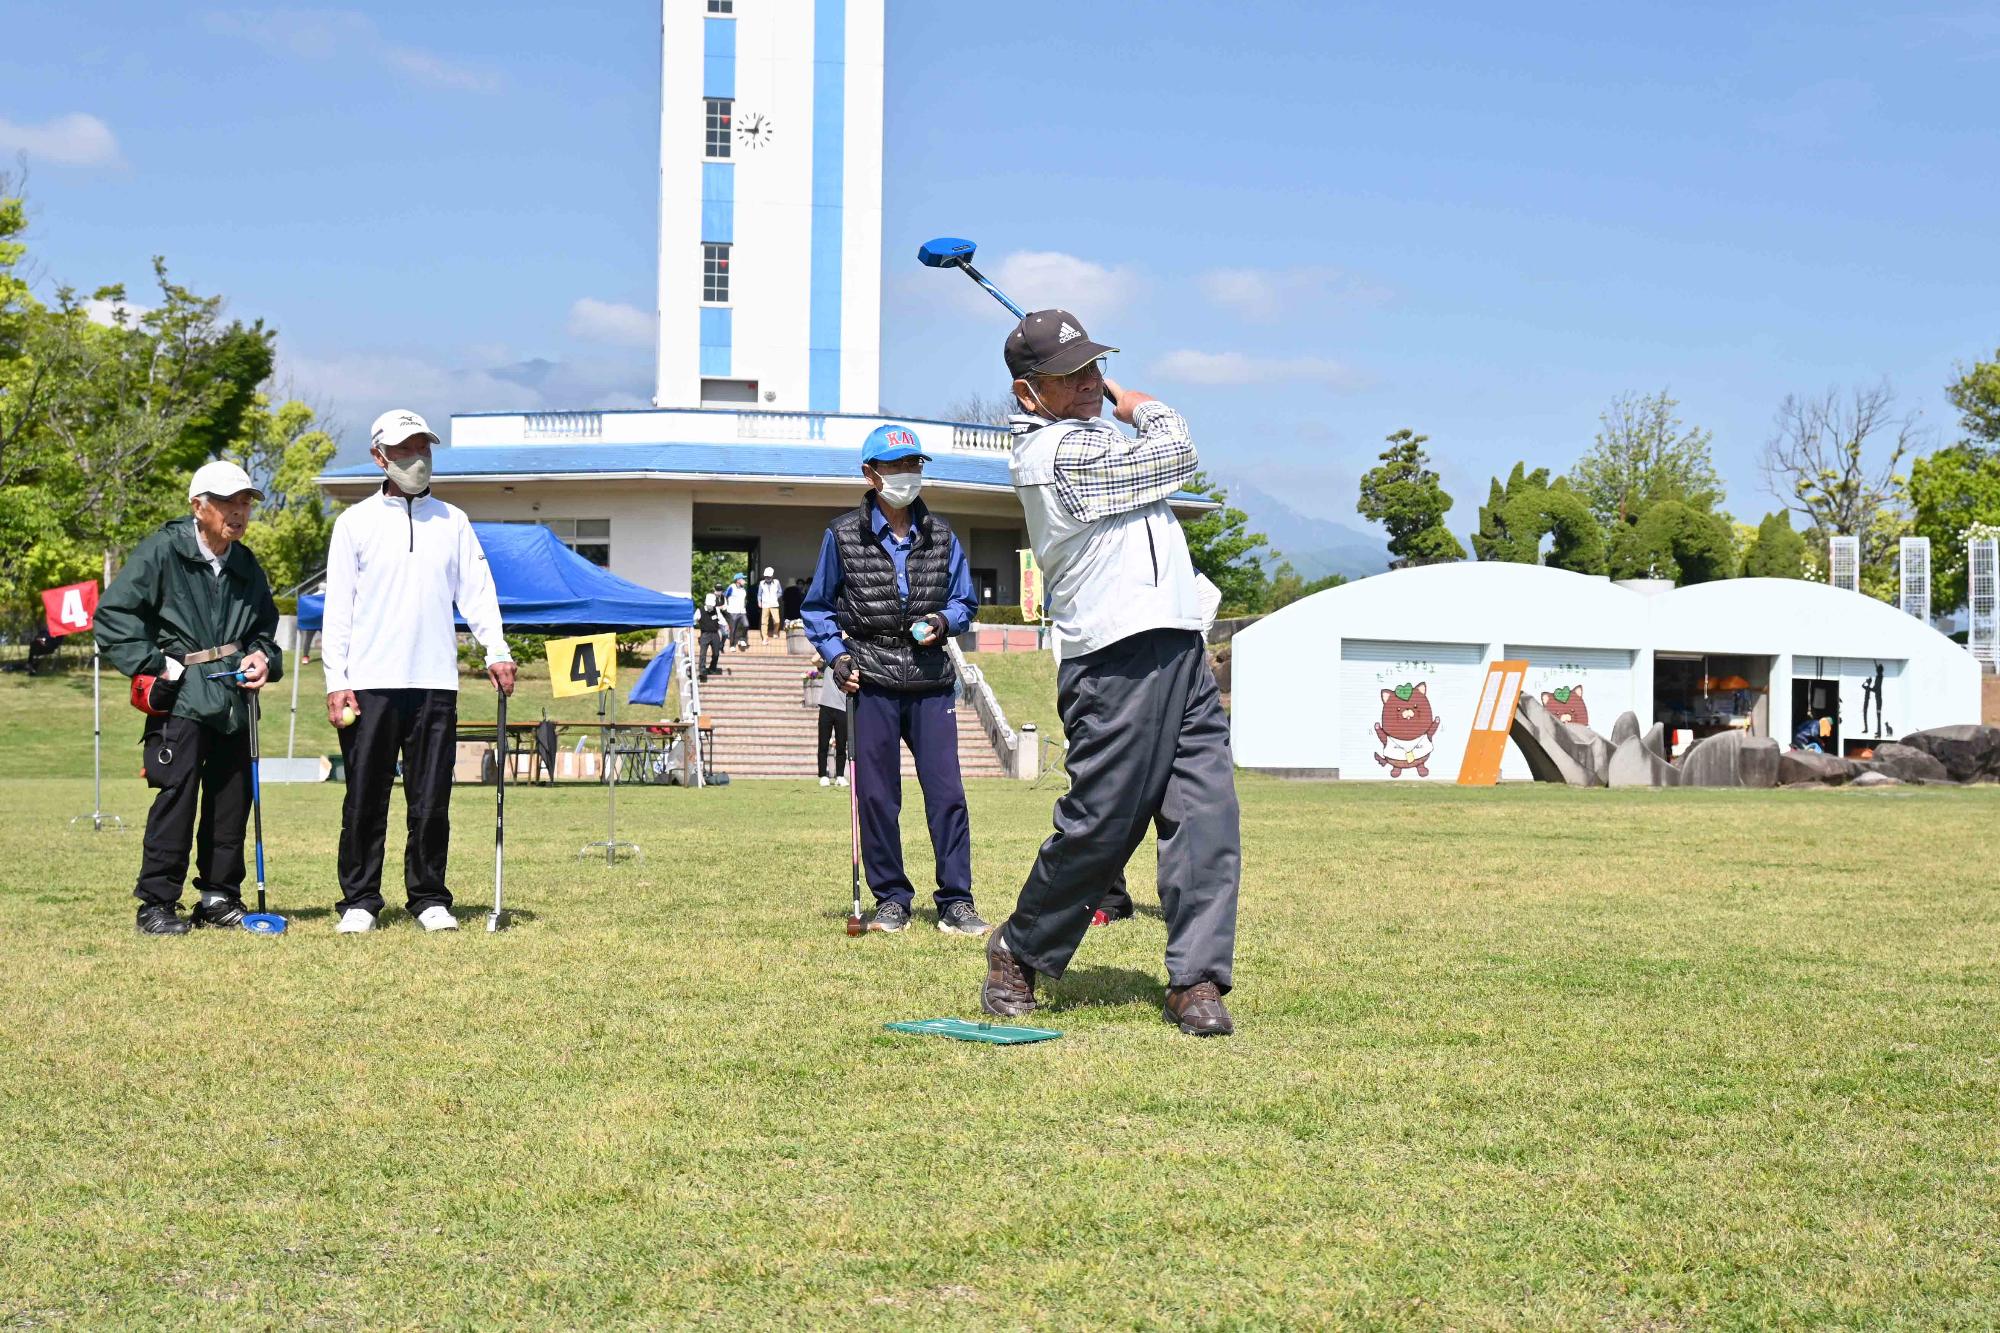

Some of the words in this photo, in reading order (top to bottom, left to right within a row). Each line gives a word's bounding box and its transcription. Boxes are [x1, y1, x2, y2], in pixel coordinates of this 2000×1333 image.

[1059, 330, 1082, 344] adidas
[886, 431, 916, 447] KAI
[61, 589, 89, 628] 4
[570, 642, 601, 688] 4
